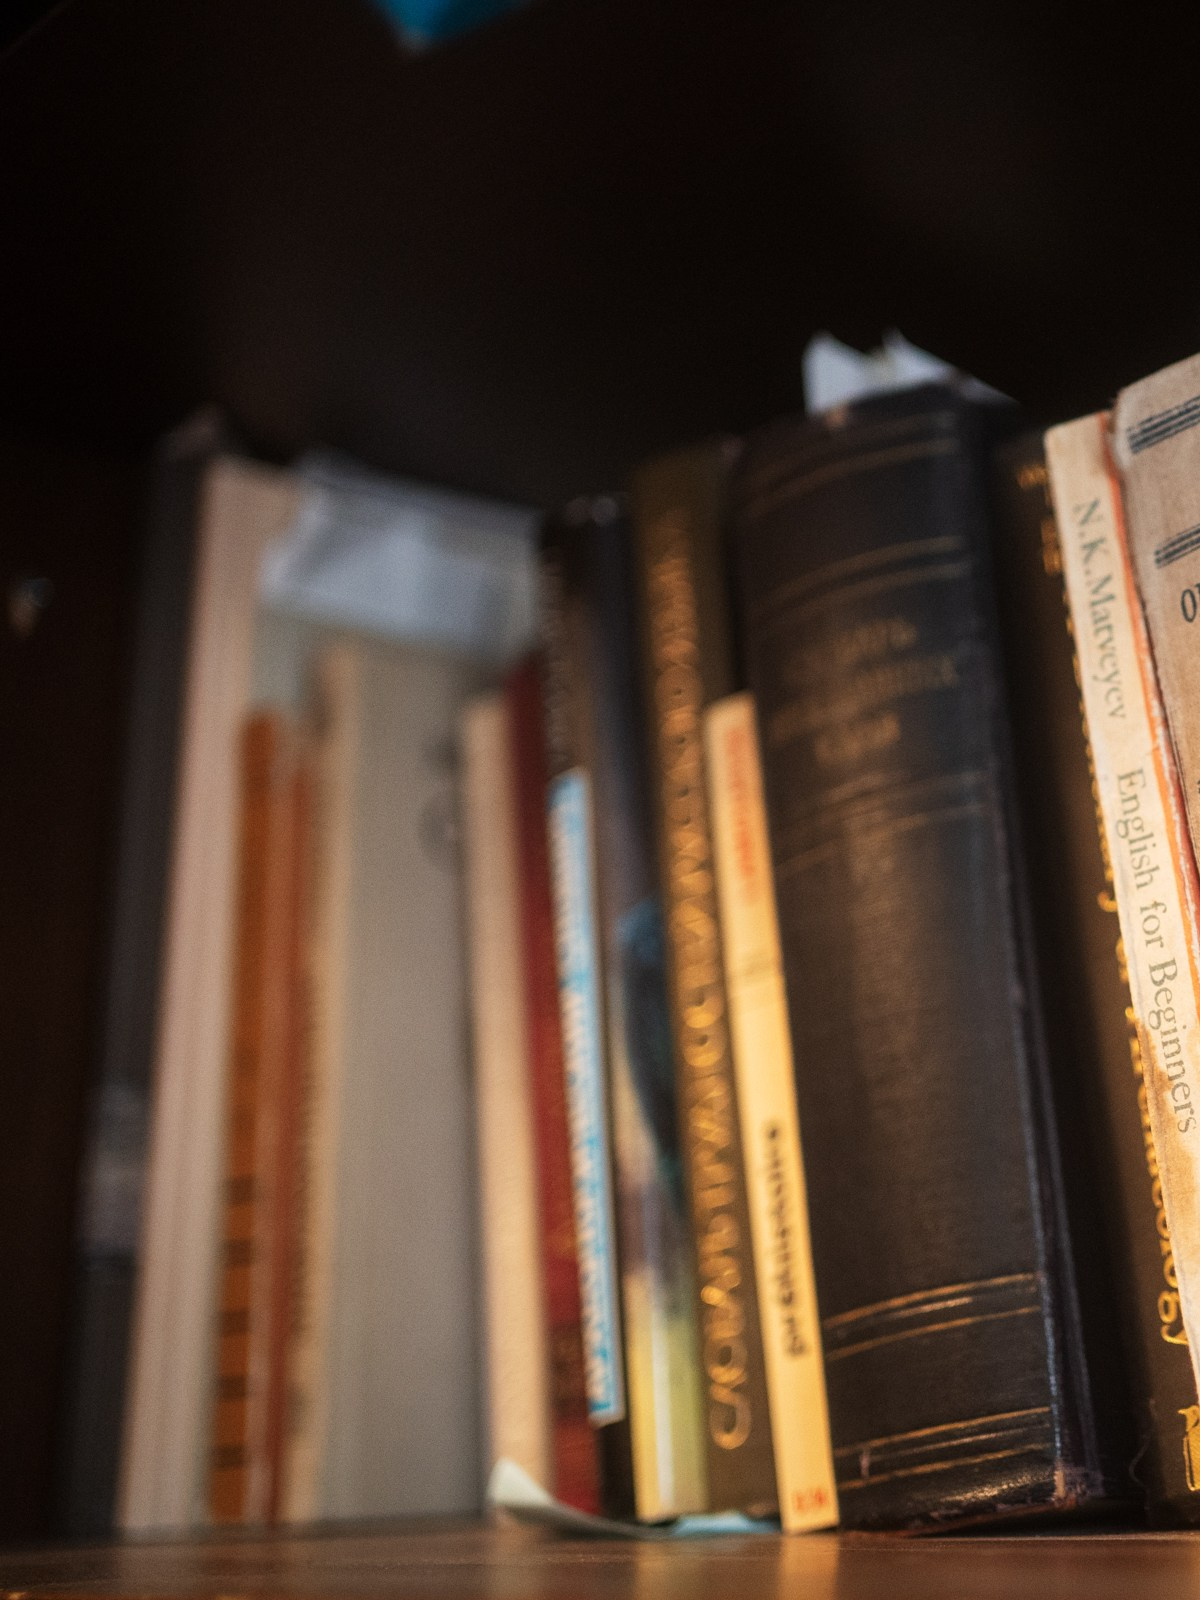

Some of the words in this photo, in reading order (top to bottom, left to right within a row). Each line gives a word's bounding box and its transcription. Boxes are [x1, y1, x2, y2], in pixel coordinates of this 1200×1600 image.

[1115, 767, 1161, 890] English
[1139, 900, 1168, 950] for
[1148, 957, 1197, 1134] Beginners
